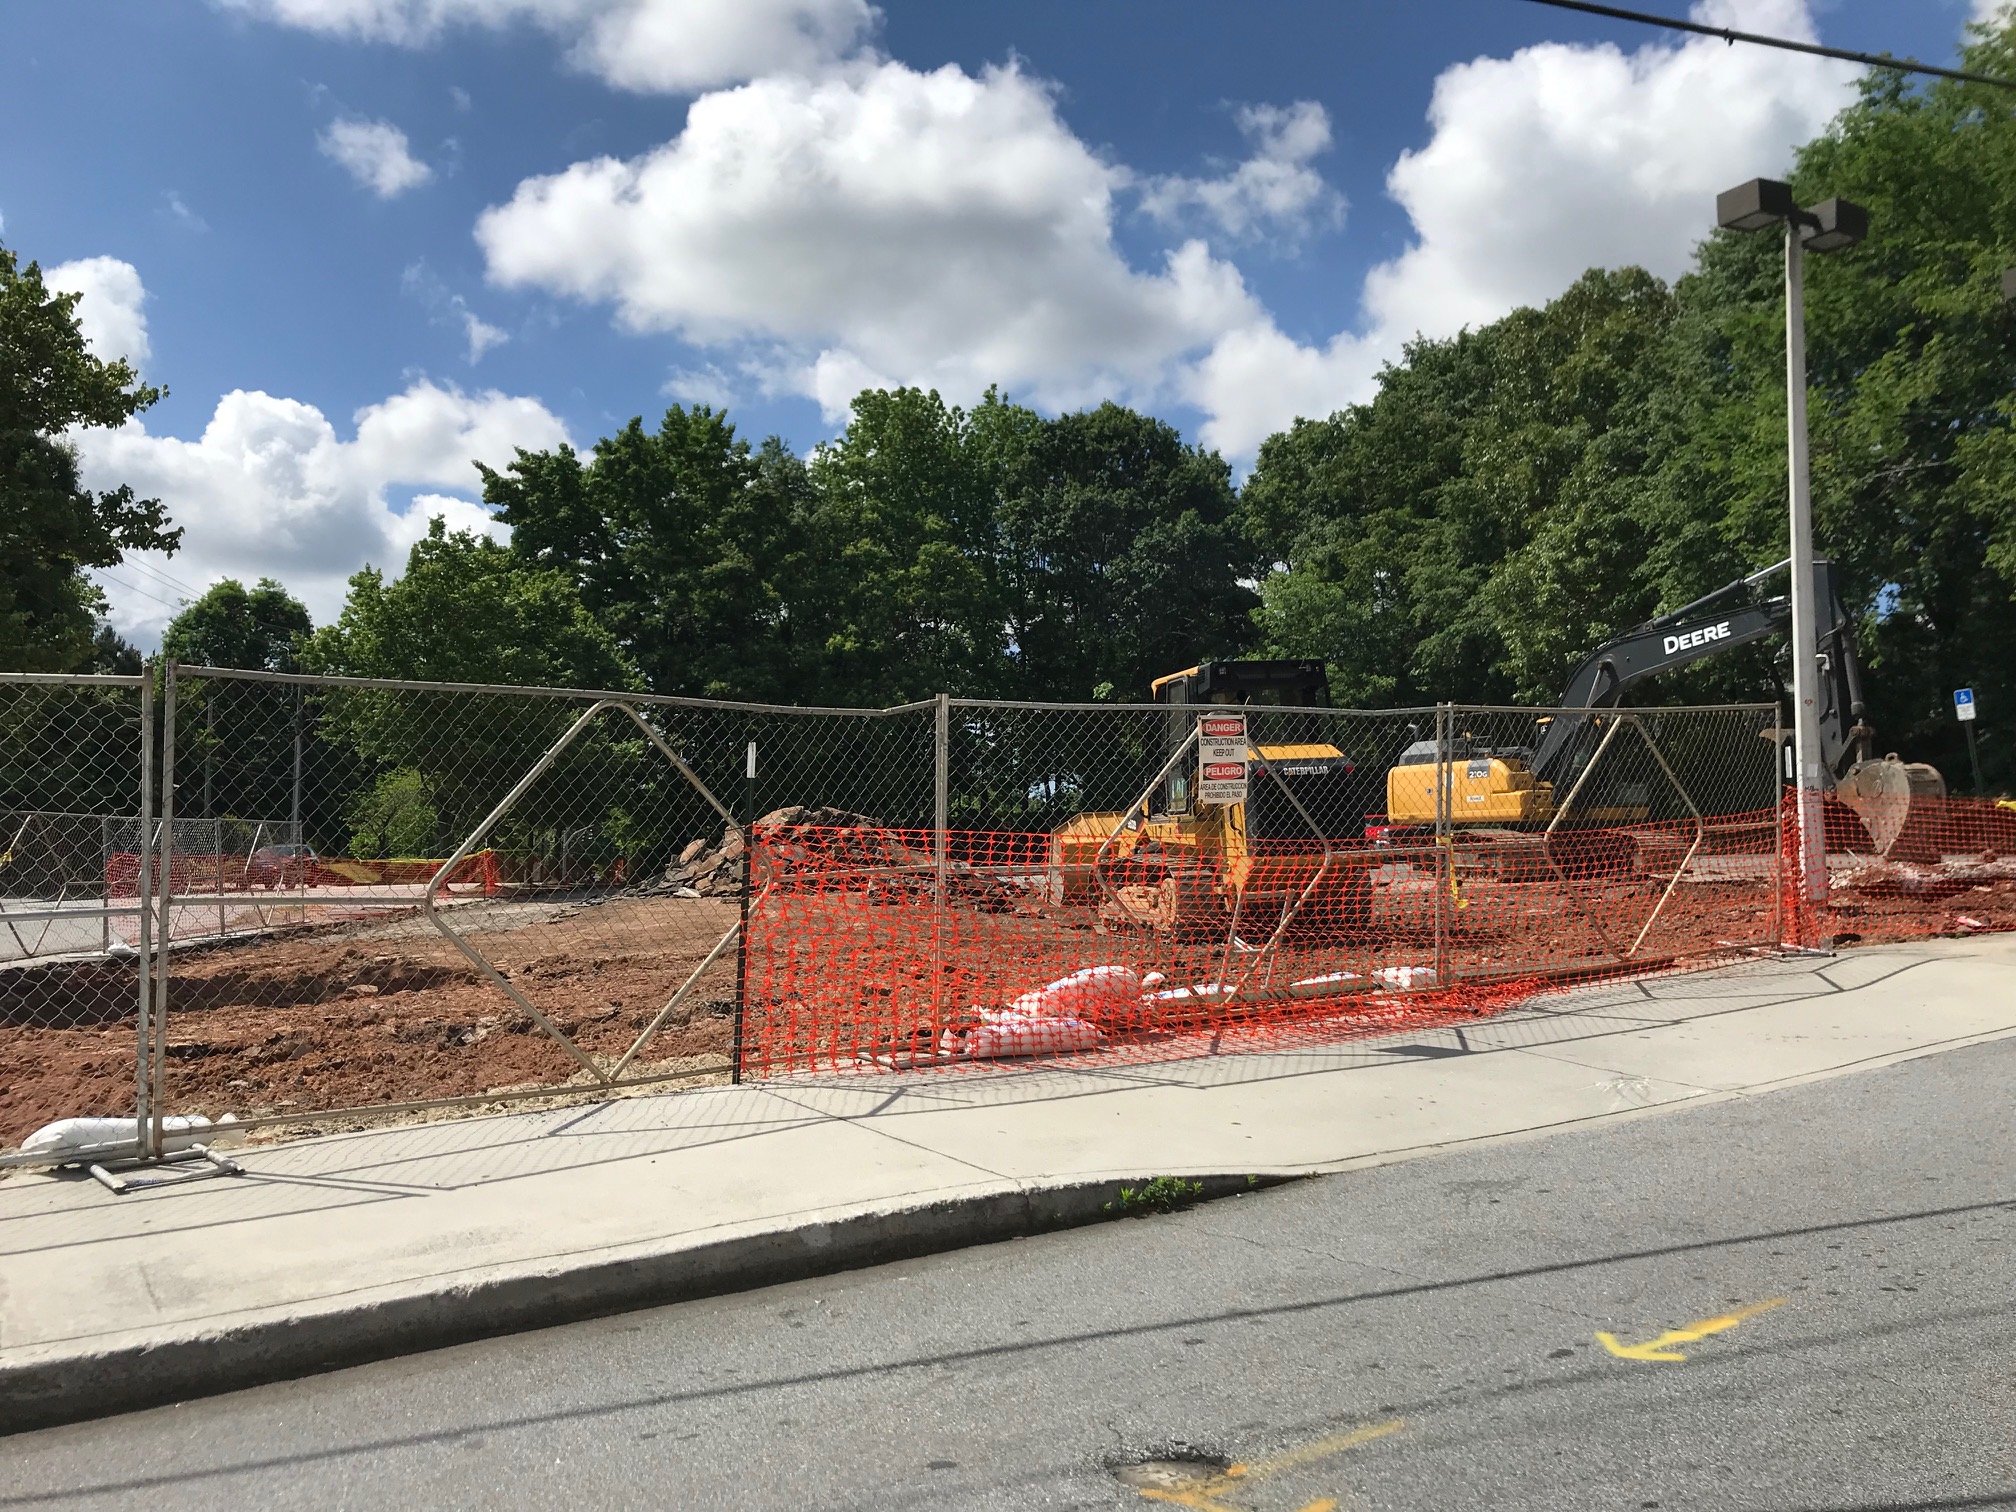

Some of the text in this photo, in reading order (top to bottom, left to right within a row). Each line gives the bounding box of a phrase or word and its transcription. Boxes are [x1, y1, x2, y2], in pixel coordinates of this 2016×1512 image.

[1663, 621, 1731, 655] DEERE
[1205, 723, 1241, 732] DANGER
[1200, 737, 1247, 746] CONSTRUCTION AREA
[1213, 748, 1235, 757] KEEP OUT
[1206, 766, 1243, 776] PELIGRO
[1283, 765, 1329, 776] CATERPILLAR
[1200, 783, 1211, 791] AREA
[1205, 791, 1226, 799] PROHIBIDO
[1232, 790, 1243, 798] PASO
